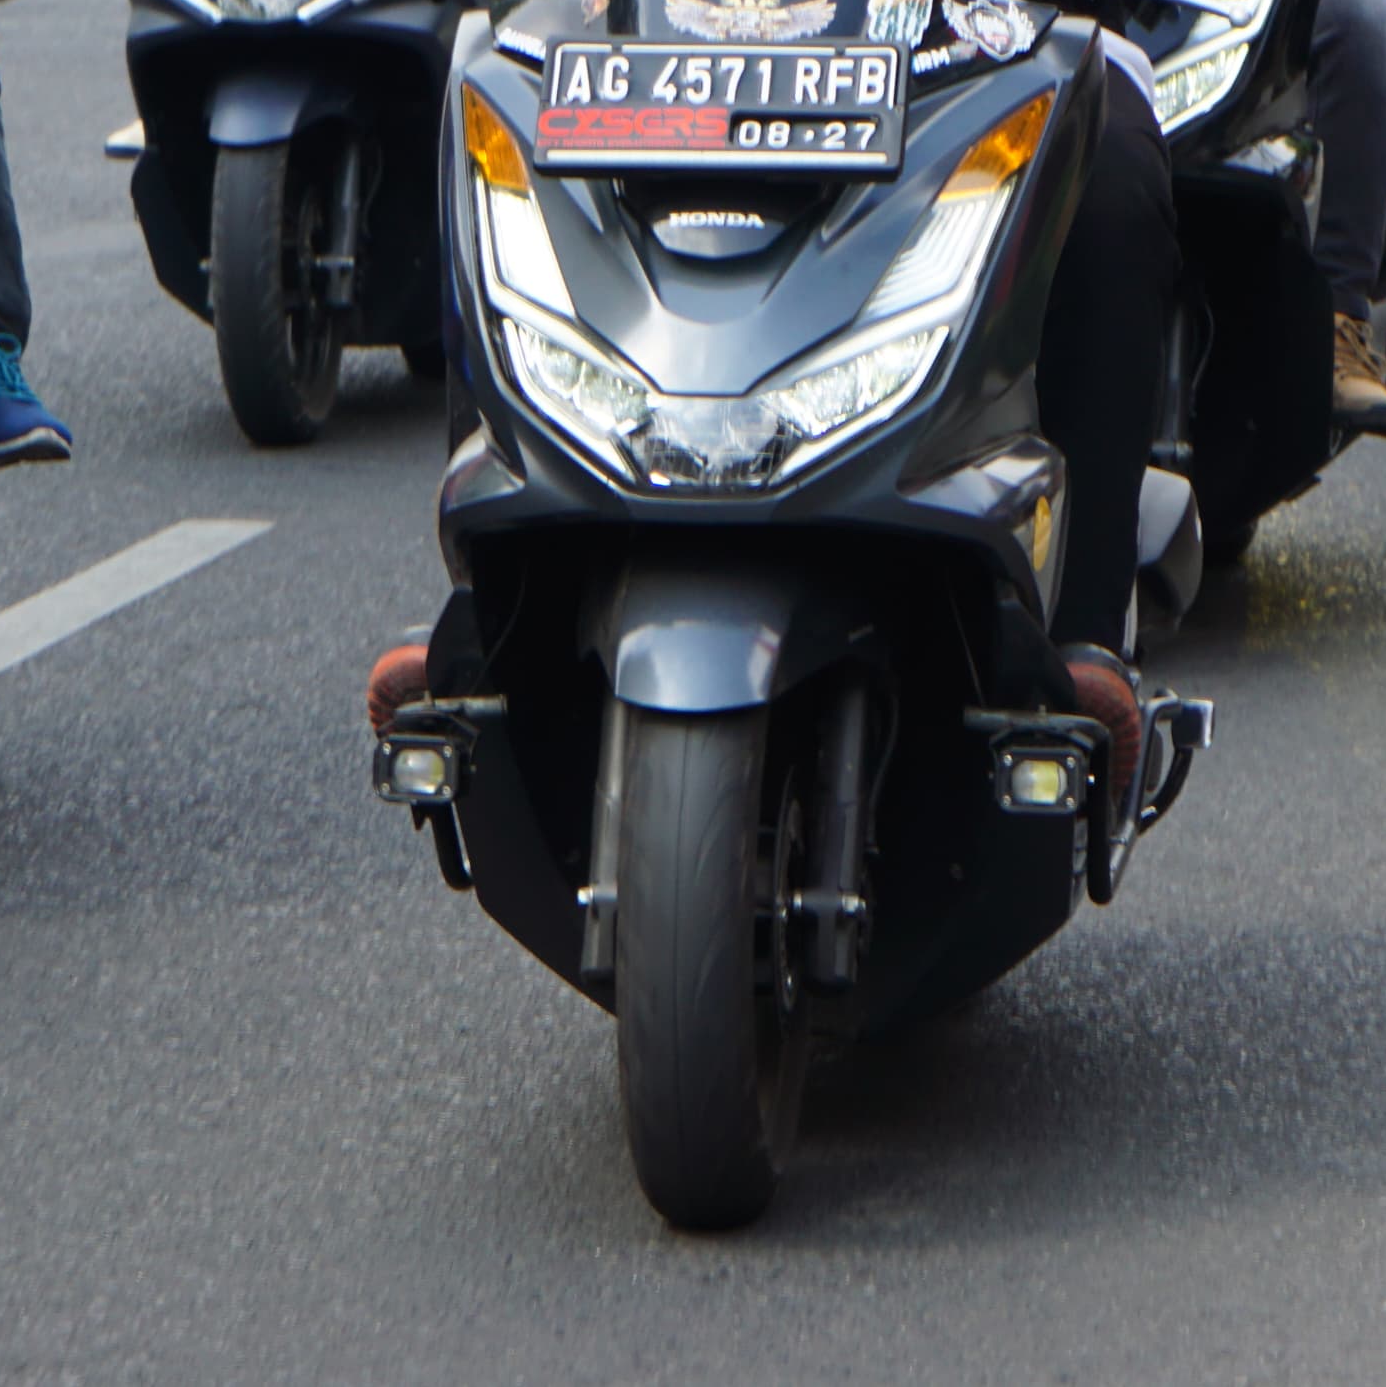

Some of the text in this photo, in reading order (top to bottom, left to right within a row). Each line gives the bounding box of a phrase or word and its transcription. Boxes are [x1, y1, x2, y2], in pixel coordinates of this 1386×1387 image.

[565, 55, 888, 106] AG 4571 RFB
[669, 211, 765, 230] HONDA
